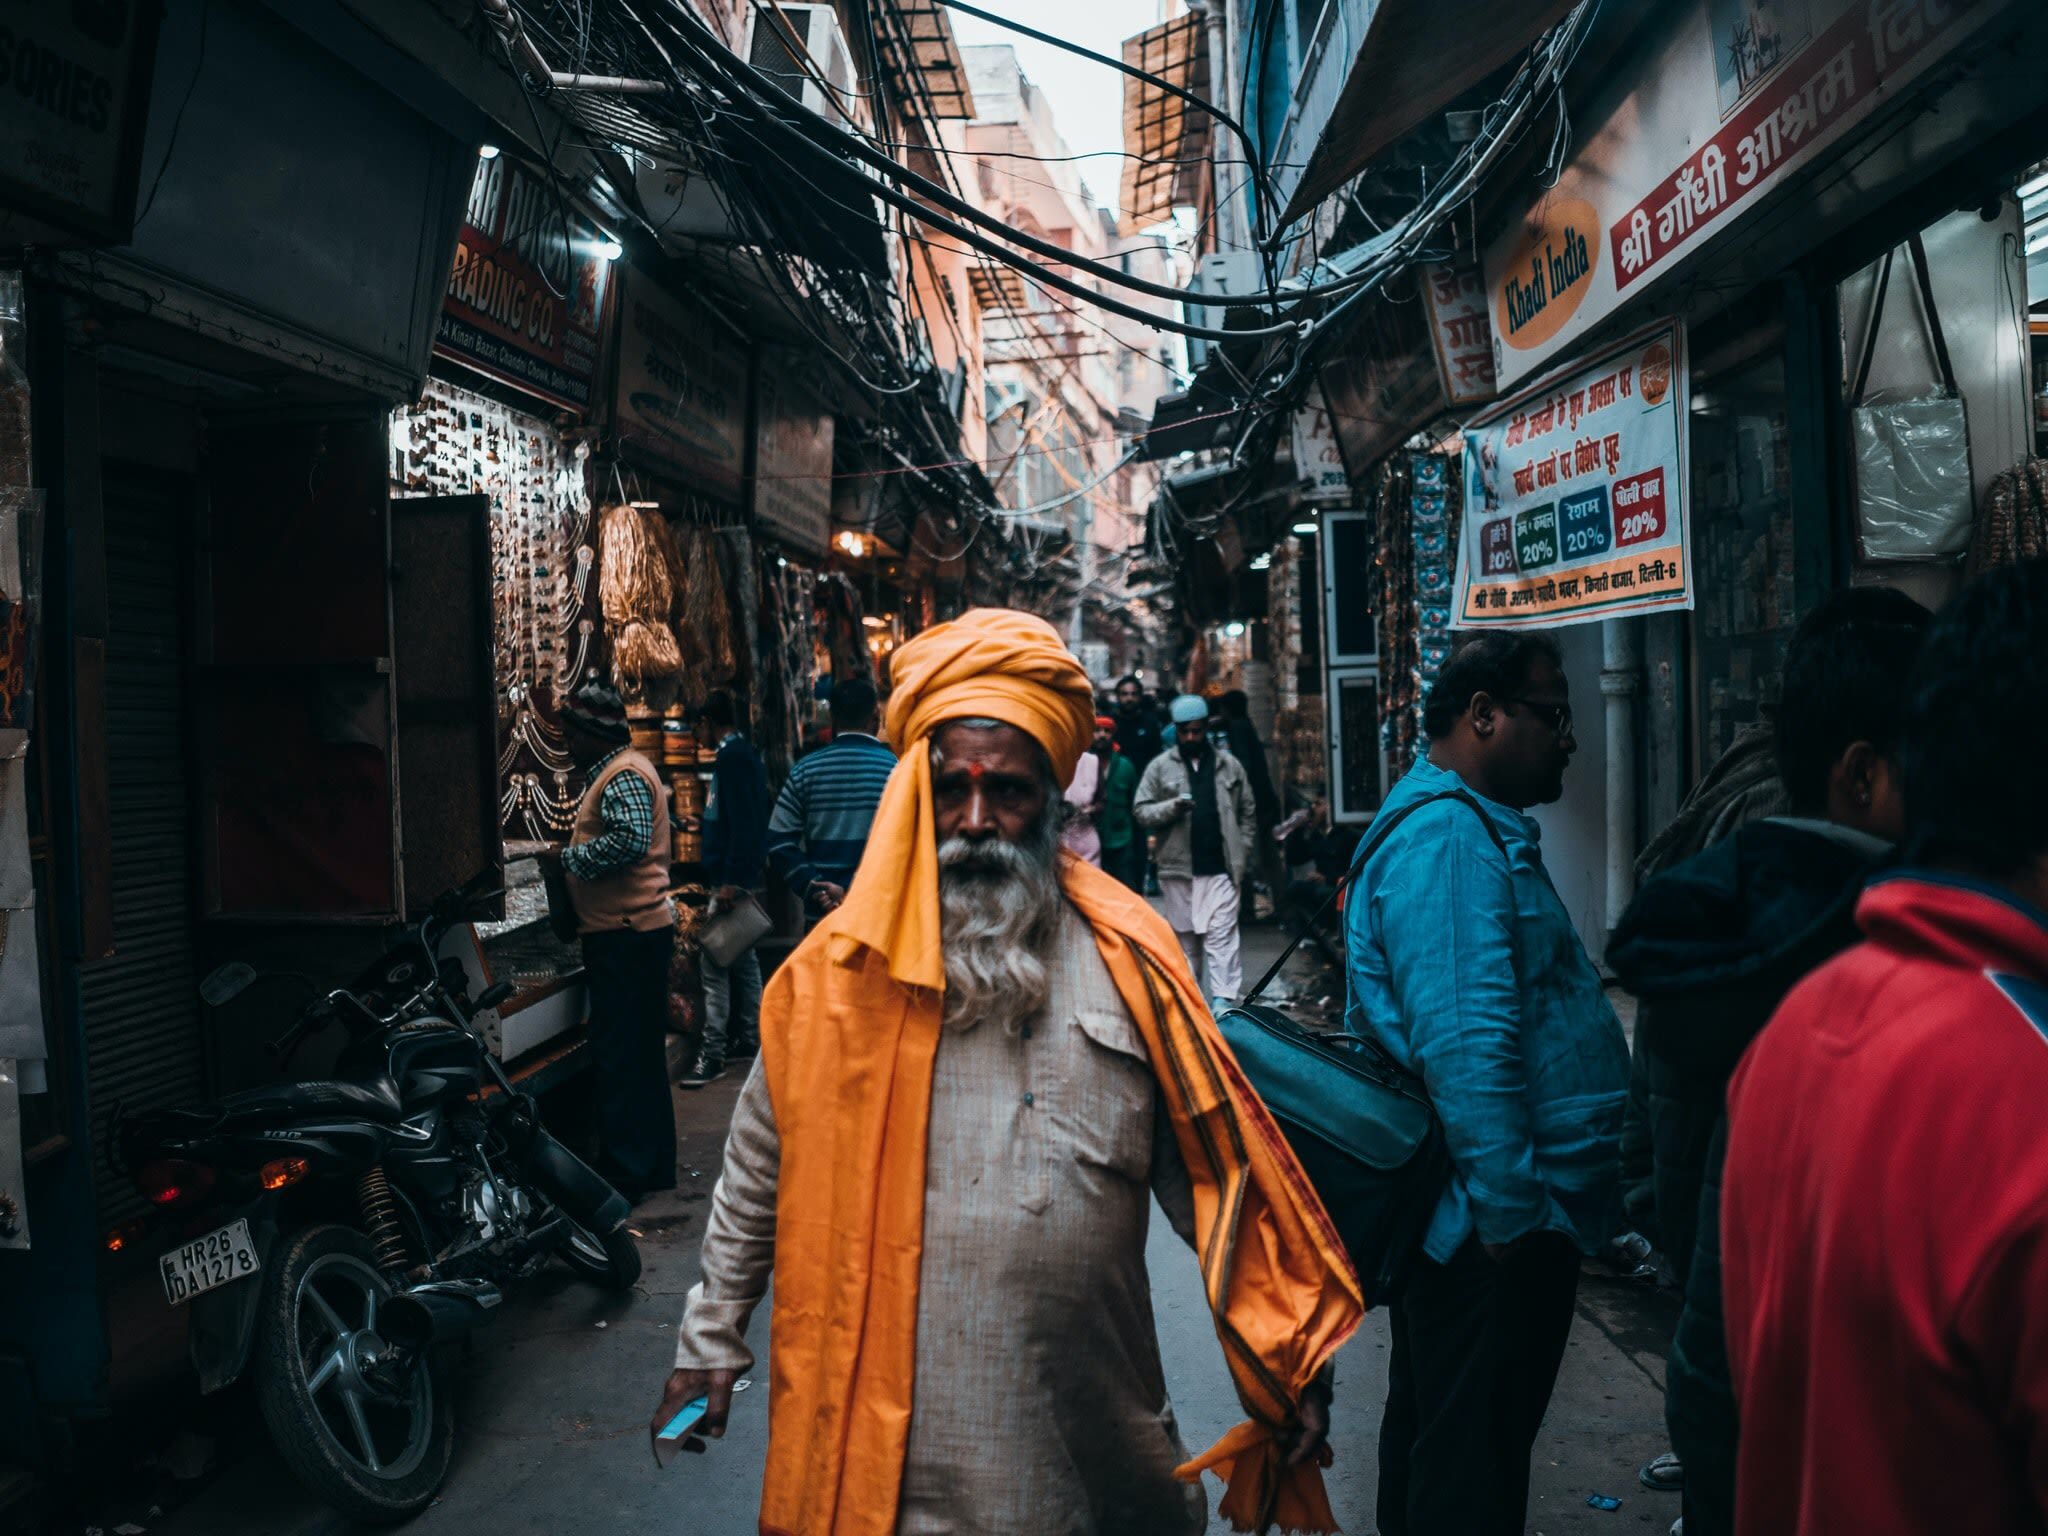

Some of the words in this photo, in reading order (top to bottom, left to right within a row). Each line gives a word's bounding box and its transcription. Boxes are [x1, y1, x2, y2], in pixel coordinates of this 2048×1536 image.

[1619, 207, 1653, 276] श्री
[1655, 143, 1728, 244] गाँधी
[1735, 38, 1856, 188] आश्रम
[449, 241, 527, 332] RADING
[528, 290, 554, 348] CO.
[1505, 256, 1547, 335] Khadi
[1545, 226, 1590, 300] India
[1587, 374, 1617, 414] अवसर
[1619, 366, 1633, 399] पर
[1560, 450, 1572, 480] पर
[1565, 498, 1601, 521] रेशम
[1621, 508, 1658, 541] 20%
[1522, 538, 1553, 565] 20%
[1566, 526, 1605, 553] 20%
[1474, 589, 1488, 609] श्री
[181, 1230, 231, 1271] HR26
[174, 1249, 253, 1299] DA1278
